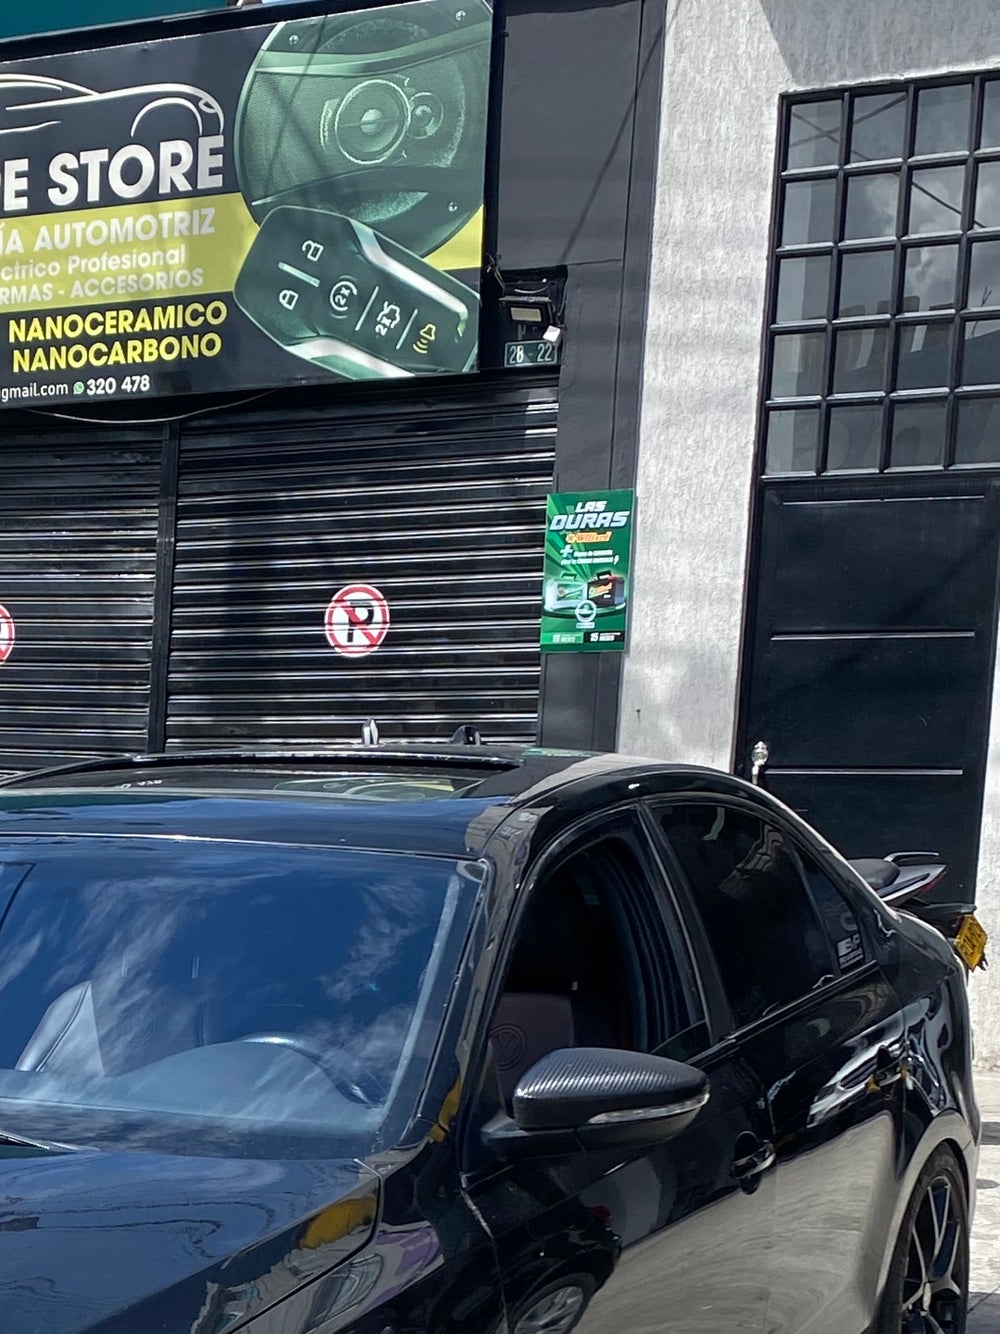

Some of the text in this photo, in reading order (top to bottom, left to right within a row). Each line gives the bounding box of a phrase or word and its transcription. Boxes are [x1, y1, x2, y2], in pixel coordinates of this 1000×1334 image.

[48, 134, 225, 206] STORE
[35, 207, 215, 252] AUTOMOTRIZ
[68, 244, 186, 275] Profesional
[70, 268, 204, 298] ACCESORIOS
[8, 300, 228, 344] NANOCERAMICO
[12, 333, 222, 374] NANOCARBONO
[87, 379, 116, 397] 320
[121, 375, 150, 393] 478
[550, 511, 630, 531] DURAS
[575, 501, 607, 513] LAS
